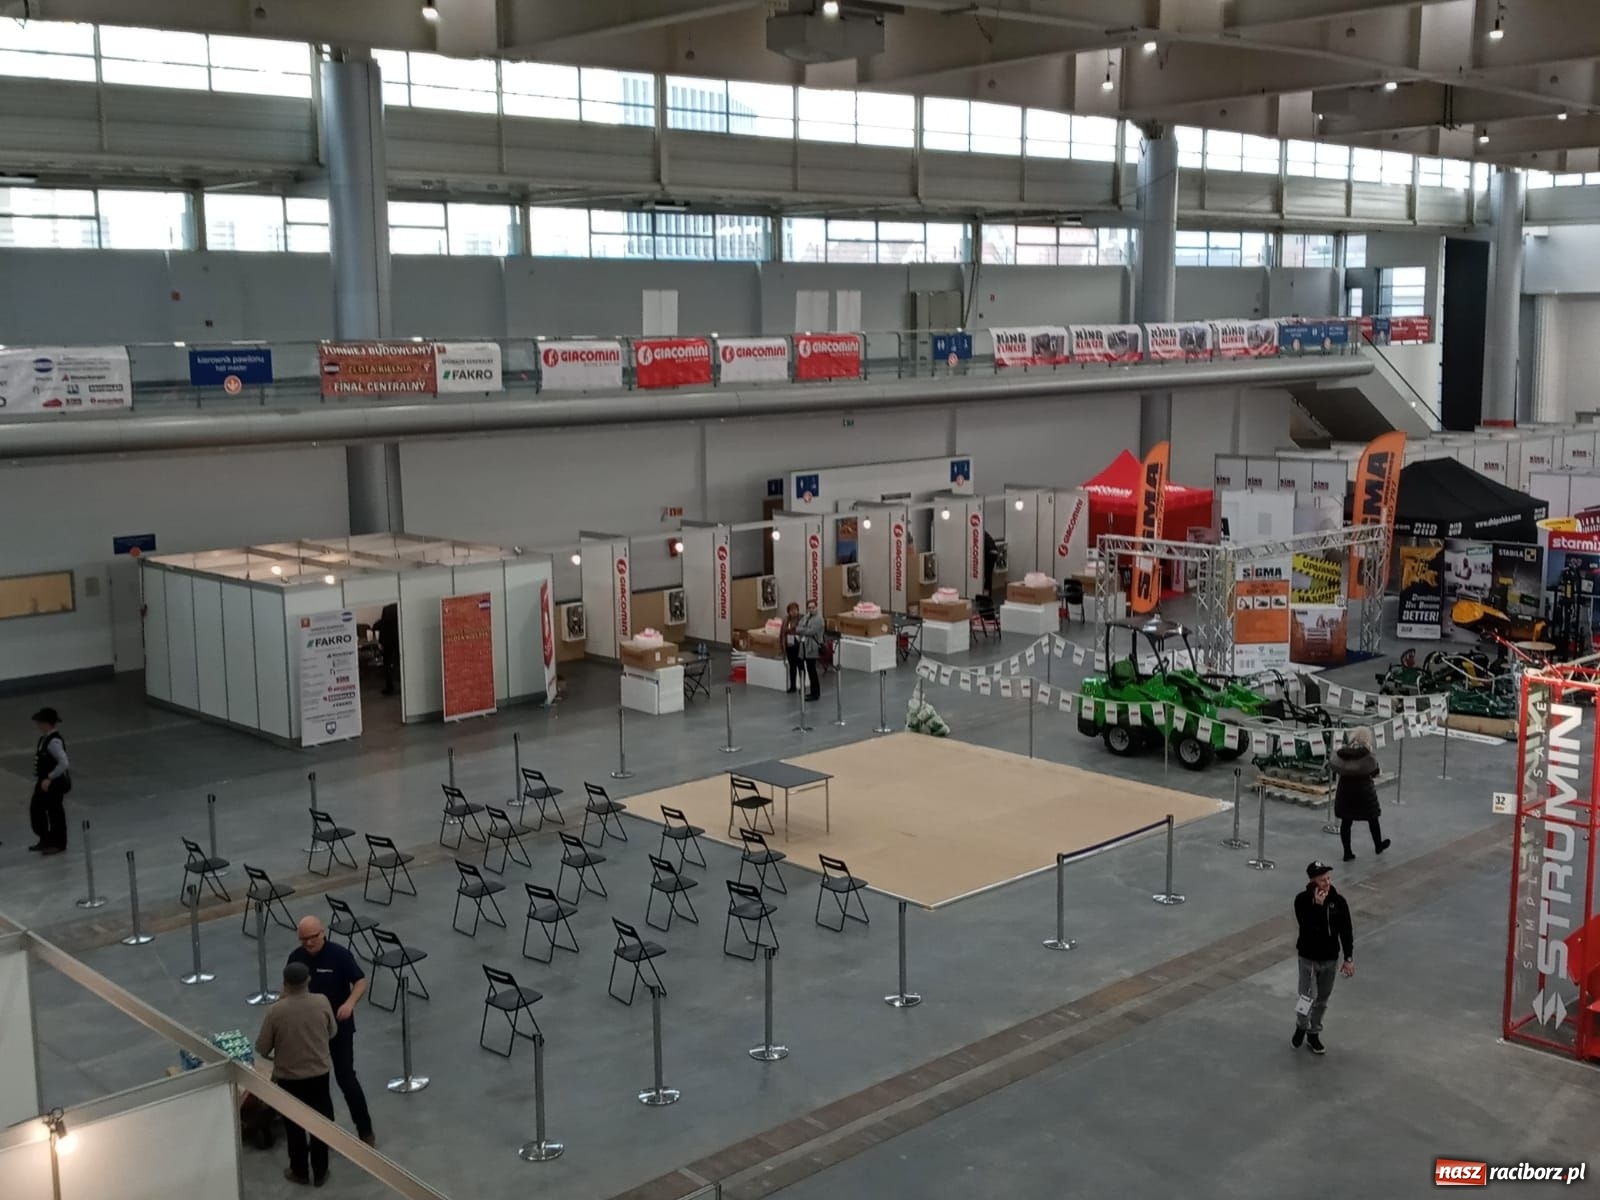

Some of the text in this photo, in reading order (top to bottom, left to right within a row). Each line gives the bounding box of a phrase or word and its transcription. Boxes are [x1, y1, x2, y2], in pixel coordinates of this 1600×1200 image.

[368, 343, 433, 356] BUDOWLANY
[654, 345, 709, 360] GIACOMINI
[736, 346, 786, 358] GIACOMINI
[812, 341, 858, 353] GIACOMINI
[560, 350, 620, 362] GIACOMINI
[452, 369, 493, 380] FAKRO
[367, 381, 426, 392] CENTRALNY
[1063, 497, 1084, 545] GIACOMINI
[971, 528, 980, 580] GIACOMINI
[895, 538, 904, 592] GIACOMINI
[810, 550, 819, 604] GIACOMIN
[719, 562, 728, 620] GIACOMINI
[618, 575, 629, 637] GIACOMINI
[315, 634, 352, 648] FAKRO
[1495, 796, 1506, 805] 32
[1522, 855, 1539, 969] SIMPLE
[1533, 702, 1547, 778] SAFE
[1537, 702, 1583, 980] STRUMIN
